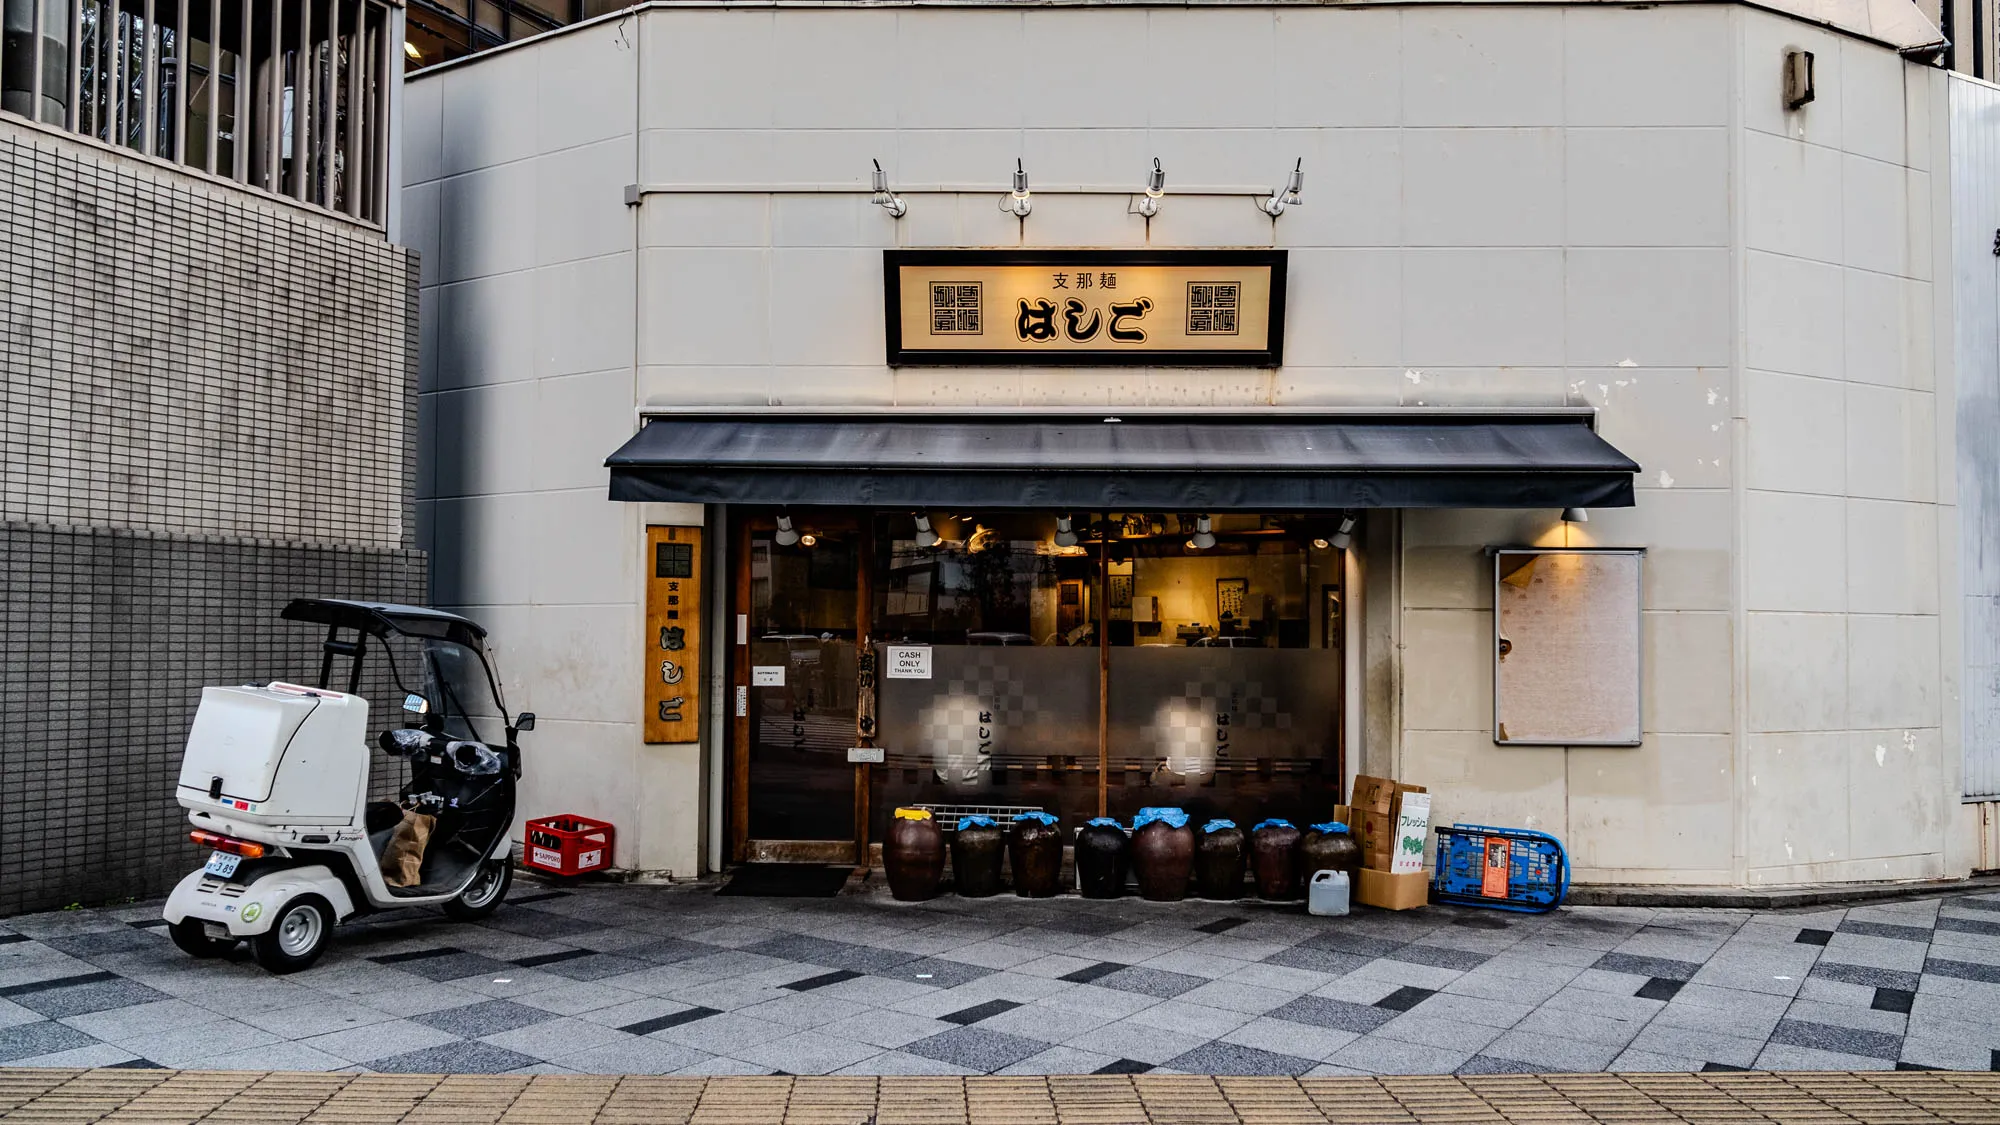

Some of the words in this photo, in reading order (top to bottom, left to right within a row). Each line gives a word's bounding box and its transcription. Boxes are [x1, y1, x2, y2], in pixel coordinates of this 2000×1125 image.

[1052, 272, 1117, 289] 支那麺
[1016, 296, 1154, 343] はしご
[667, 581, 679, 619] 支那
[659, 626, 684, 721] はしご
[898, 651, 921, 659] CASH
[899, 660, 920, 668] ONLY
[978, 711, 992, 755] はしご
[1216, 713, 1230, 757] はしご
[539, 852, 561, 863] SAPPORO
